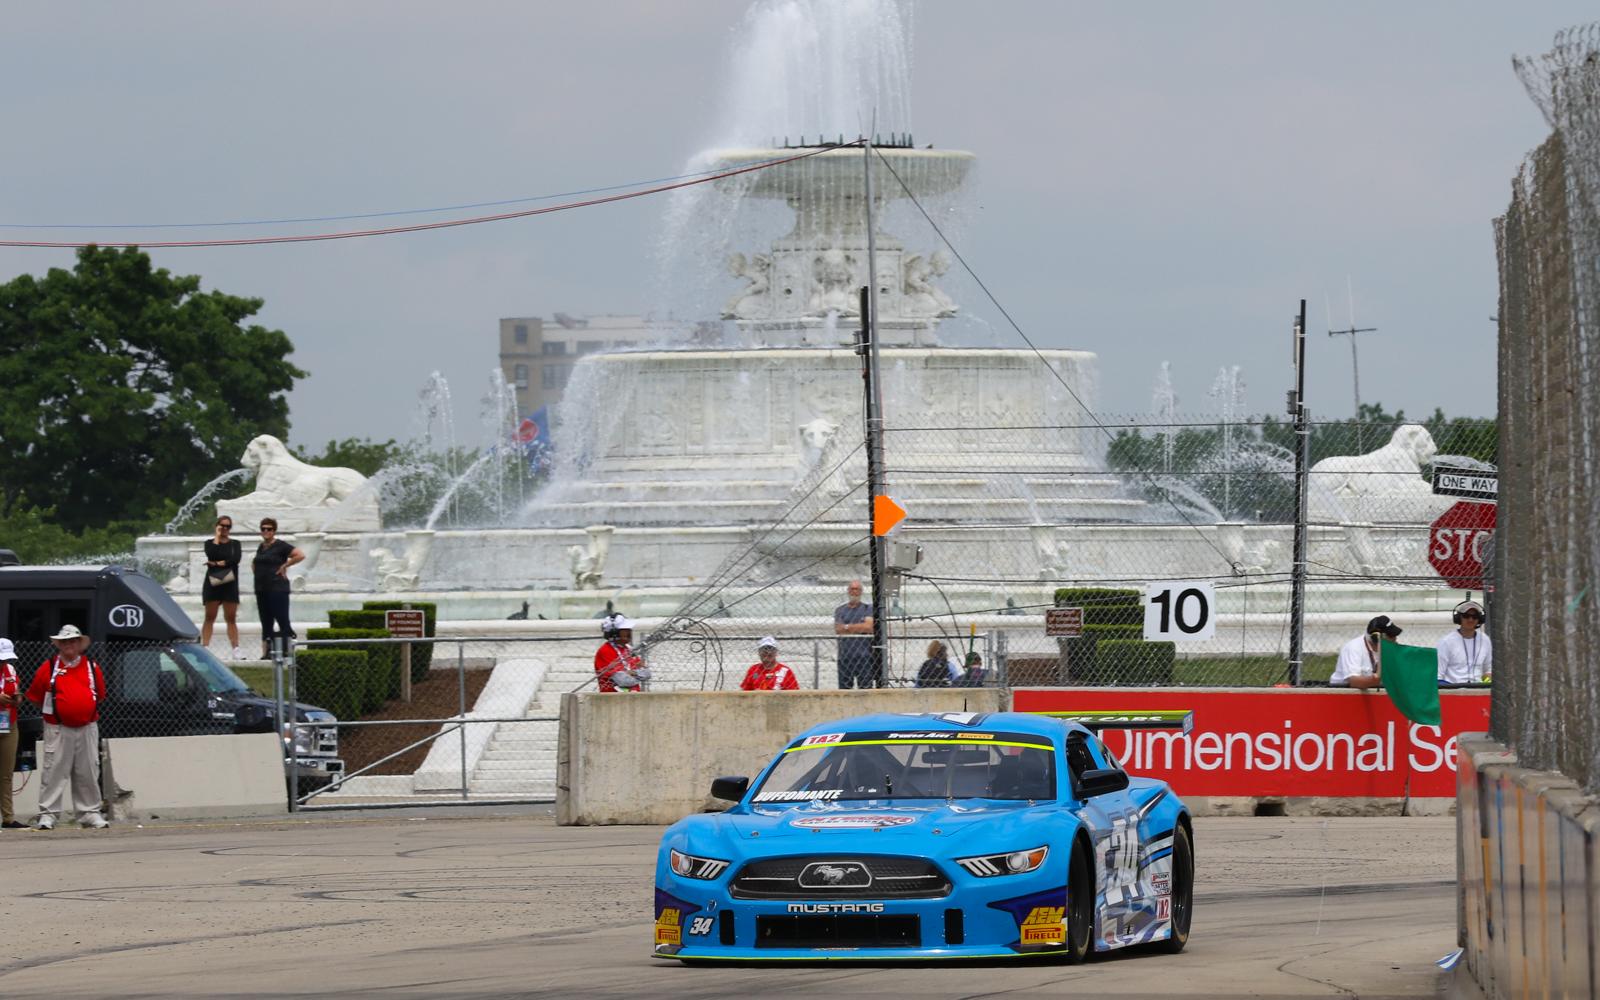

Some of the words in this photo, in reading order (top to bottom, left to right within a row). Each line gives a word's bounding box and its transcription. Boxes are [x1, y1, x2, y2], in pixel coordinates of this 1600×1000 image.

[1442, 475, 1467, 489] ONE
[1471, 478, 1496, 491] WAY
[1434, 528, 1490, 563] STO
[1151, 588, 1208, 634] 10
[808, 734, 840, 745] TA2
[1098, 720, 1394, 772] Dimensional
[787, 903, 884, 913] MUSTANG
[1022, 906, 1065, 925] AEM
[689, 917, 714, 935] 34
[1024, 927, 1062, 940] PIRELLI
